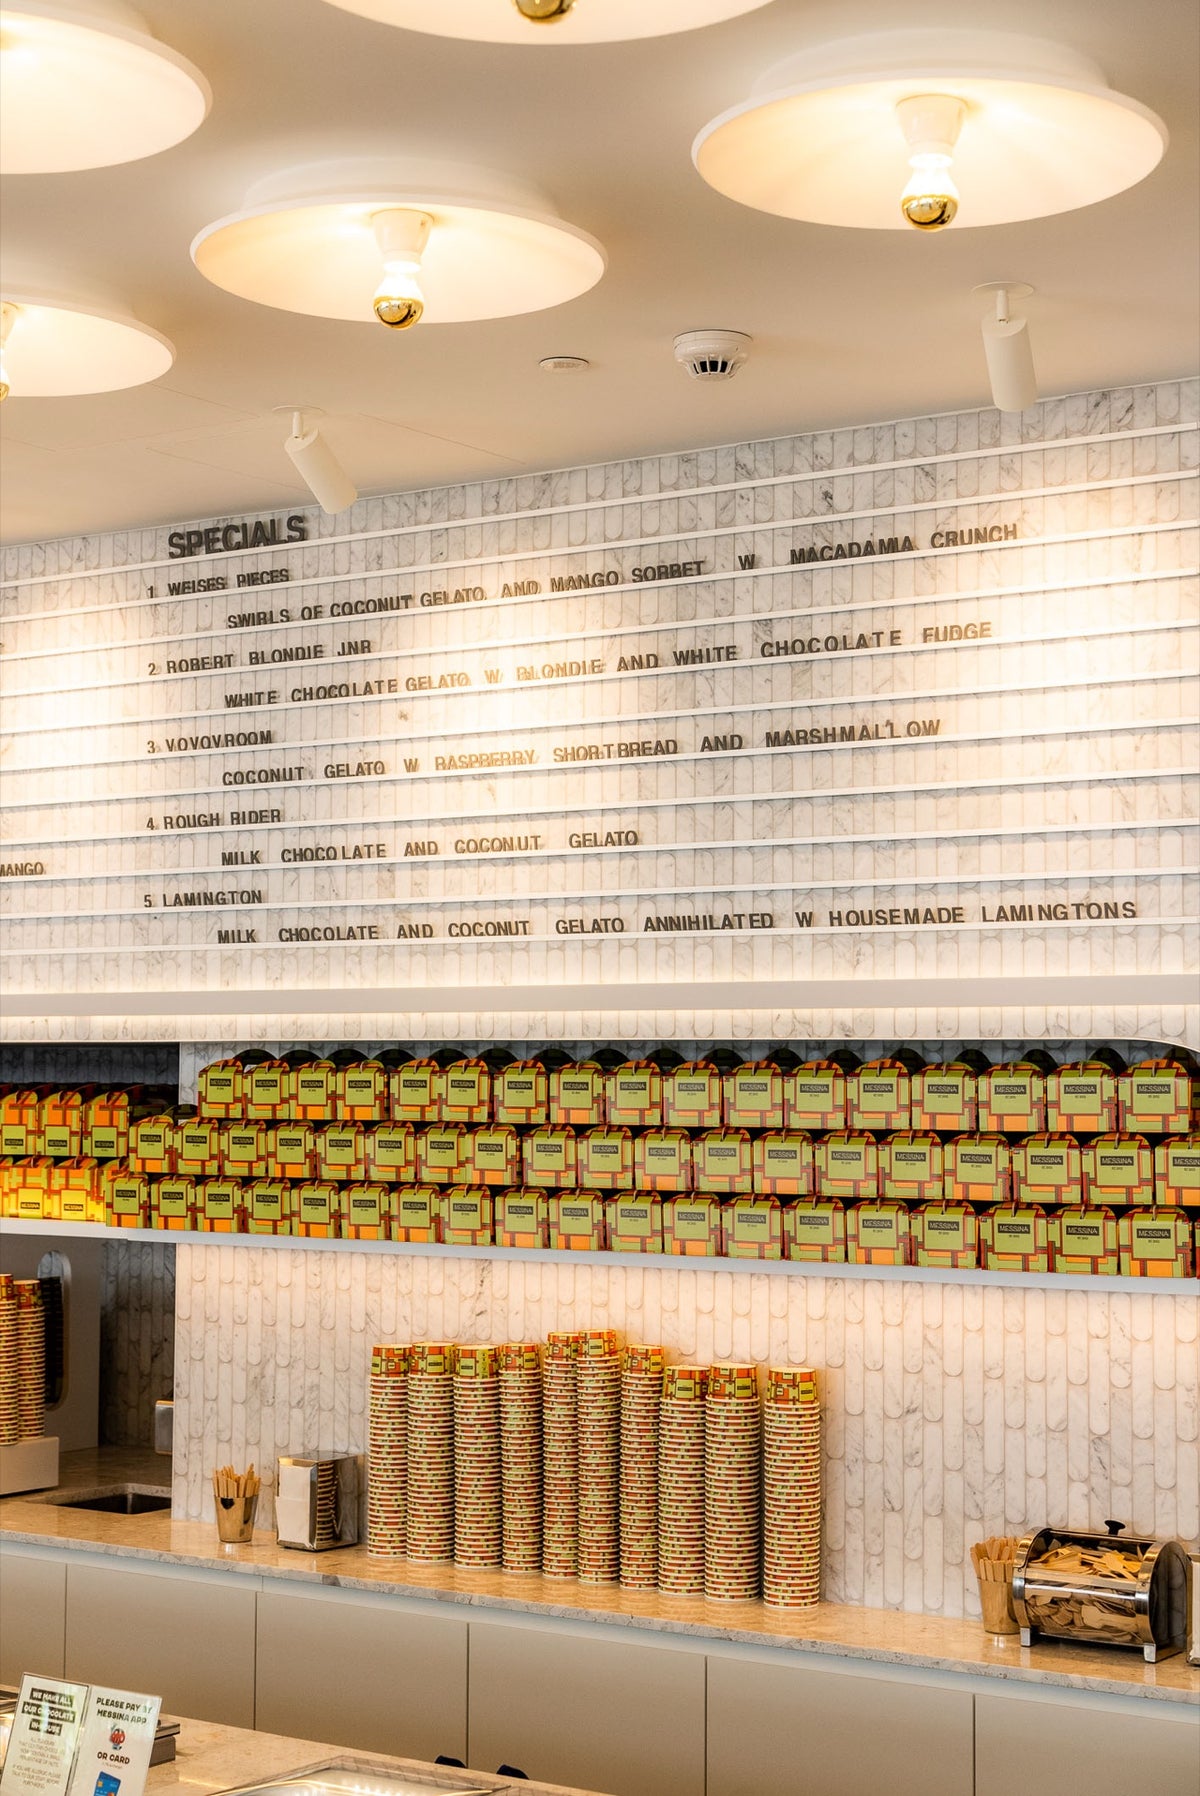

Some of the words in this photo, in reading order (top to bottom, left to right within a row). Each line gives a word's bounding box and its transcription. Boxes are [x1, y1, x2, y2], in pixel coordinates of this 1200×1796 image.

[168, 515, 306, 559] SPECIALS
[148, 586, 155, 598] 1
[168, 576, 225, 596] WEISES
[236, 569, 289, 587] PIECES
[227, 609, 290, 628] SWIRLS
[301, 605, 322, 621] OF
[330, 595, 412, 617] COCONUT
[420, 586, 486, 608] GELATO
[501, 581, 540, 599] AND
[550, 570, 619, 592] MANGO
[631, 560, 704, 583] SORBET
[738, 554, 756, 570] W
[790, 536, 913, 565] MACADAMIA
[930, 524, 1017, 549] CRUNCH
[167, 654, 234, 674] ROBERT
[249, 644, 323, 665] BLONDIE
[337, 639, 371, 656] JNR
[225, 690, 277, 708] WHITE
[291, 679, 398, 703] CHOCOLATE
[405, 673, 469, 692] GELATO
[485, 669, 502, 683] W
[517, 658, 602, 681] BLONDIE
[617, 653, 658, 671] AND
[673, 645, 737, 666] WHITE
[760, 629, 902, 658] CHOCOLATE
[922, 622, 991, 643] FUDGE
[165, 730, 272, 752] VOVOVROOM
[222, 766, 304, 786] COCONUT
[324, 761, 385, 778] GELATO
[403, 758, 419, 773] W
[435, 749, 536, 771] RASPBERRY
[553, 740, 678, 763] SHORTBREAD
[700, 734, 742, 752] AND
[163, 813, 219, 830] ROUGH
[230, 809, 280, 825] RIDER
[221, 849, 260, 866] MILK
[280, 844, 386, 862] CHOCOLATE
[404, 841, 438, 857] AND
[454, 835, 540, 854] COCONUT
[569, 831, 638, 849] GELATO
[144, 894, 152, 907] 5
[163, 890, 262, 907] LAMINGTON
[218, 929, 256, 944] MILK
[278, 925, 378, 942] CHOCOLATE
[397, 923, 433, 939] AND
[448, 920, 529, 937] COCONUT
[555, 917, 624, 935] GELATO
[643, 913, 774, 932] ANNIHILATED
[795, 912, 813, 928] W
[829, 907, 964, 927] HOUSEMADE
[981, 901, 1136, 923] LAMINGTONS
[1138, 1085, 1169, 1093] MESSINA
[650, 1148, 674, 1156] MESSINA
[962, 1155, 991, 1163] MESSINA
[1032, 1156, 1062, 1164] MESSINA
[1102, 1157, 1133, 1165] MESSINA
[564, 1208, 587, 1216] MESSINA
[929, 1222, 958, 1230] MESSINA
[999, 1225, 1029, 1233] MESSINA
[1067, 1227, 1098, 1235] MESSINA
[96, 1697, 124, 1709] PLEASE
[126, 1703, 140, 1711] PAY
[97, 1709, 129, 1721] MESSINA
[130, 1715, 147, 1724] APP
[97, 1751, 107, 1760] OR
[110, 1754, 130, 1764] CARD
